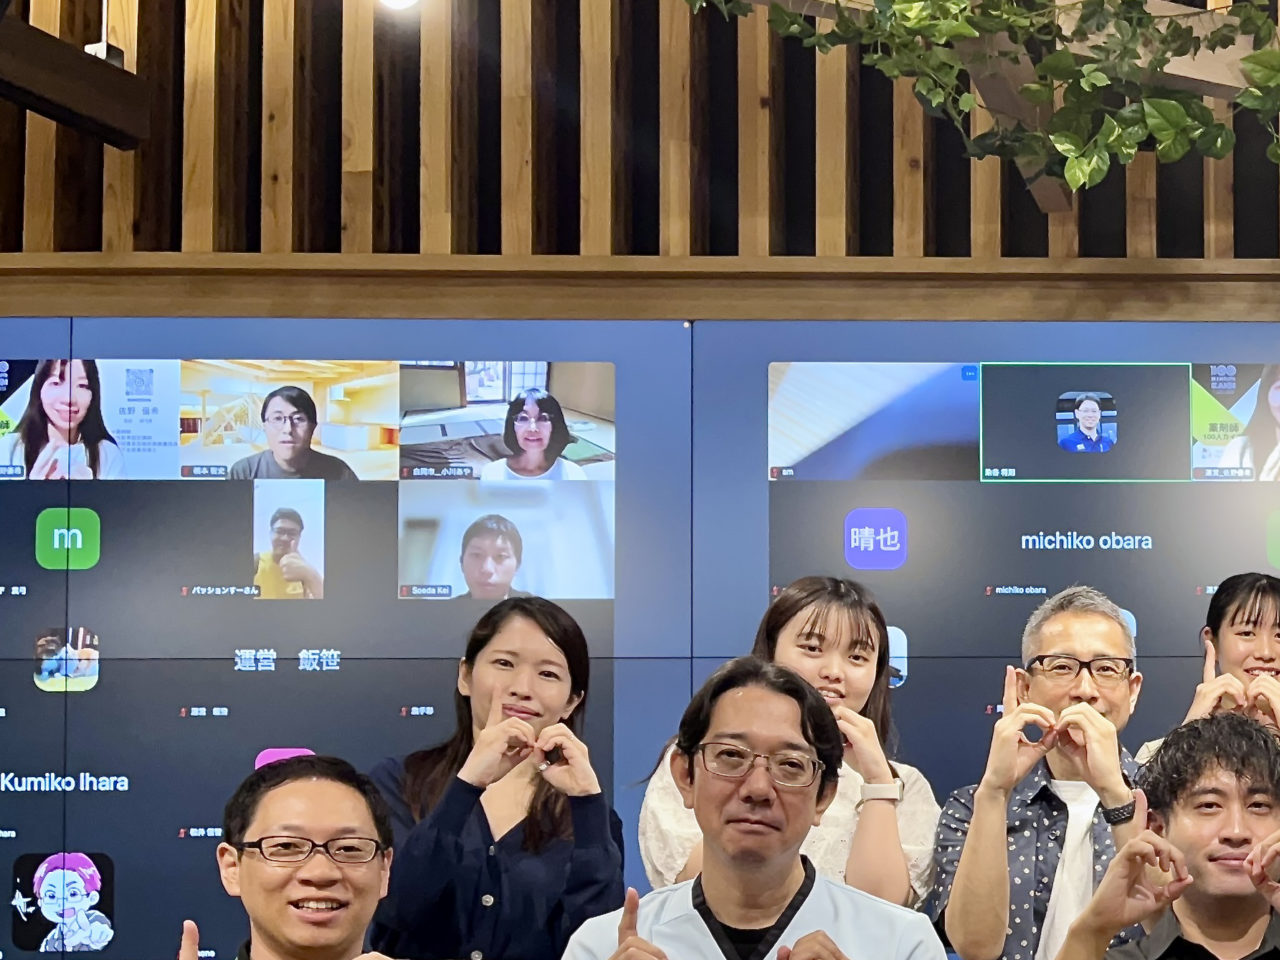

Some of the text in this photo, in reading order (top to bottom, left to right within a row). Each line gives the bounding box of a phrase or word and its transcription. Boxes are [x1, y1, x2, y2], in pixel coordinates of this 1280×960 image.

[53, 526, 82, 549] m
[850, 526, 901, 552] 晴也
[1021, 531, 1153, 549] michiko obara
[234, 649, 341, 671] 運営 飯笹
[0, 772, 129, 791] Kumiko Ihara
